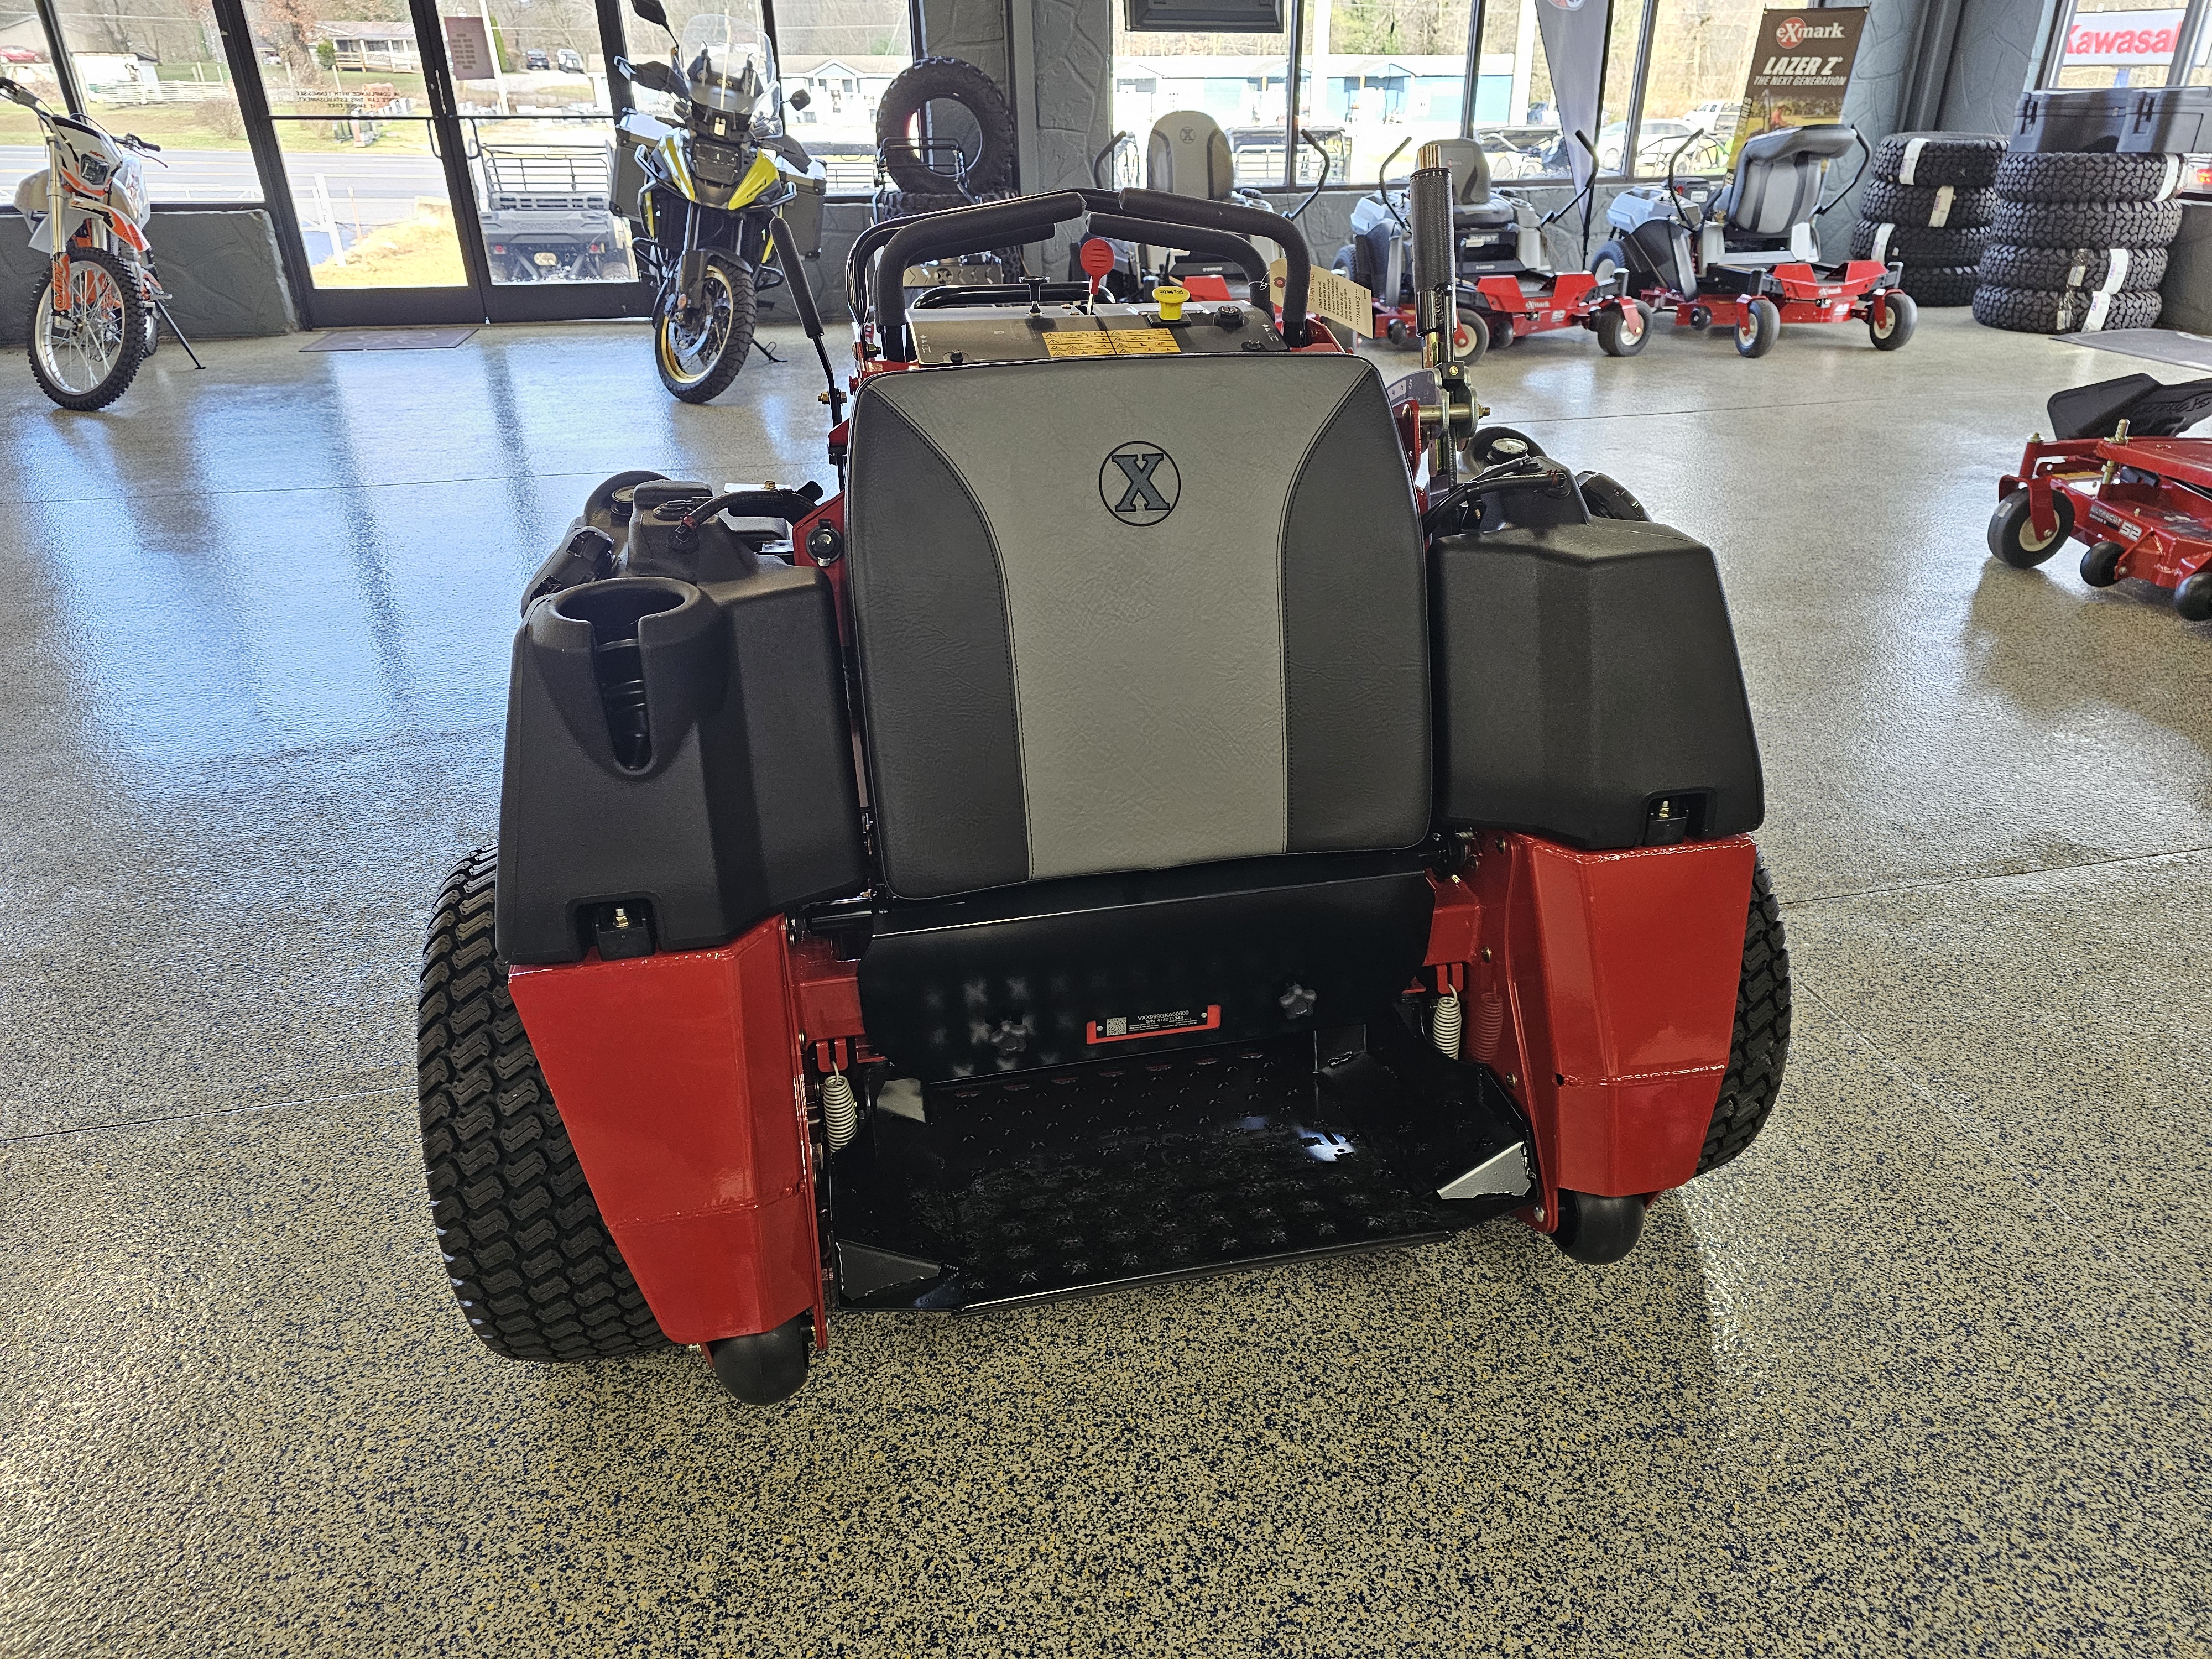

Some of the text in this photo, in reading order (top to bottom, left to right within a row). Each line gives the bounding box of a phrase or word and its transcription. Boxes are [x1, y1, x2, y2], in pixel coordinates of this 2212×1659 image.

[1776, 22, 1845, 43] eXmark
[1762, 56, 1823, 75] LAZER
[1754, 76, 1847, 86] THE NEXT GENERATION
[2119, 520, 2142, 543] 52
[1138, 1010, 1190, 1021] VXX999GKA60600
